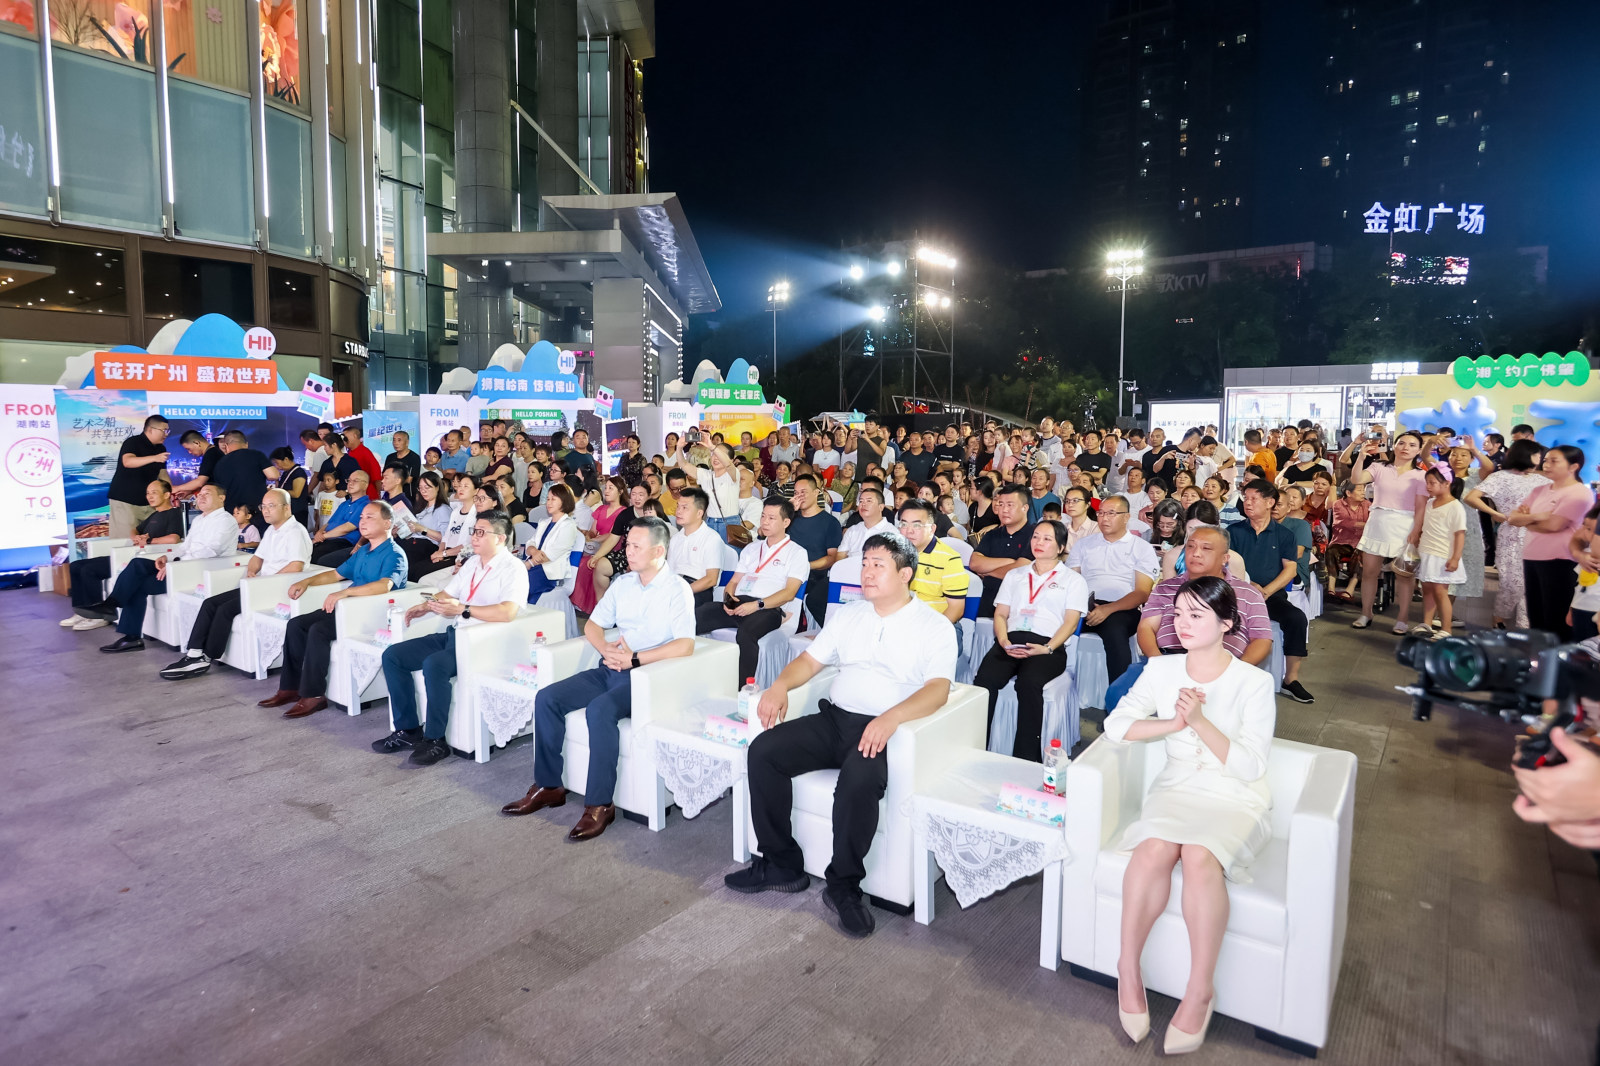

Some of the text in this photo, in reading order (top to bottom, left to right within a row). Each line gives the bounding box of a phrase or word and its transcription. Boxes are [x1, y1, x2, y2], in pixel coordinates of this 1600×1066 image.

[1363, 201, 1485, 235] 金虹广场
[248, 334, 272, 351] HI!
[560, 356, 575, 368] HI!
[102, 361, 272, 385] 花开广州 盛放世界
[533, 379, 576, 393] 传奇佛山
[4, 403, 57, 416] FROM
[164, 407, 263, 417] HELLO GUANGZHOU
[430, 408, 459, 418] FROM
[668, 412, 687, 420] FROM
[72, 416, 116, 433] 艺术之船
[91, 425, 136, 441] 共享狂欢
[25, 496, 52, 508] TO
